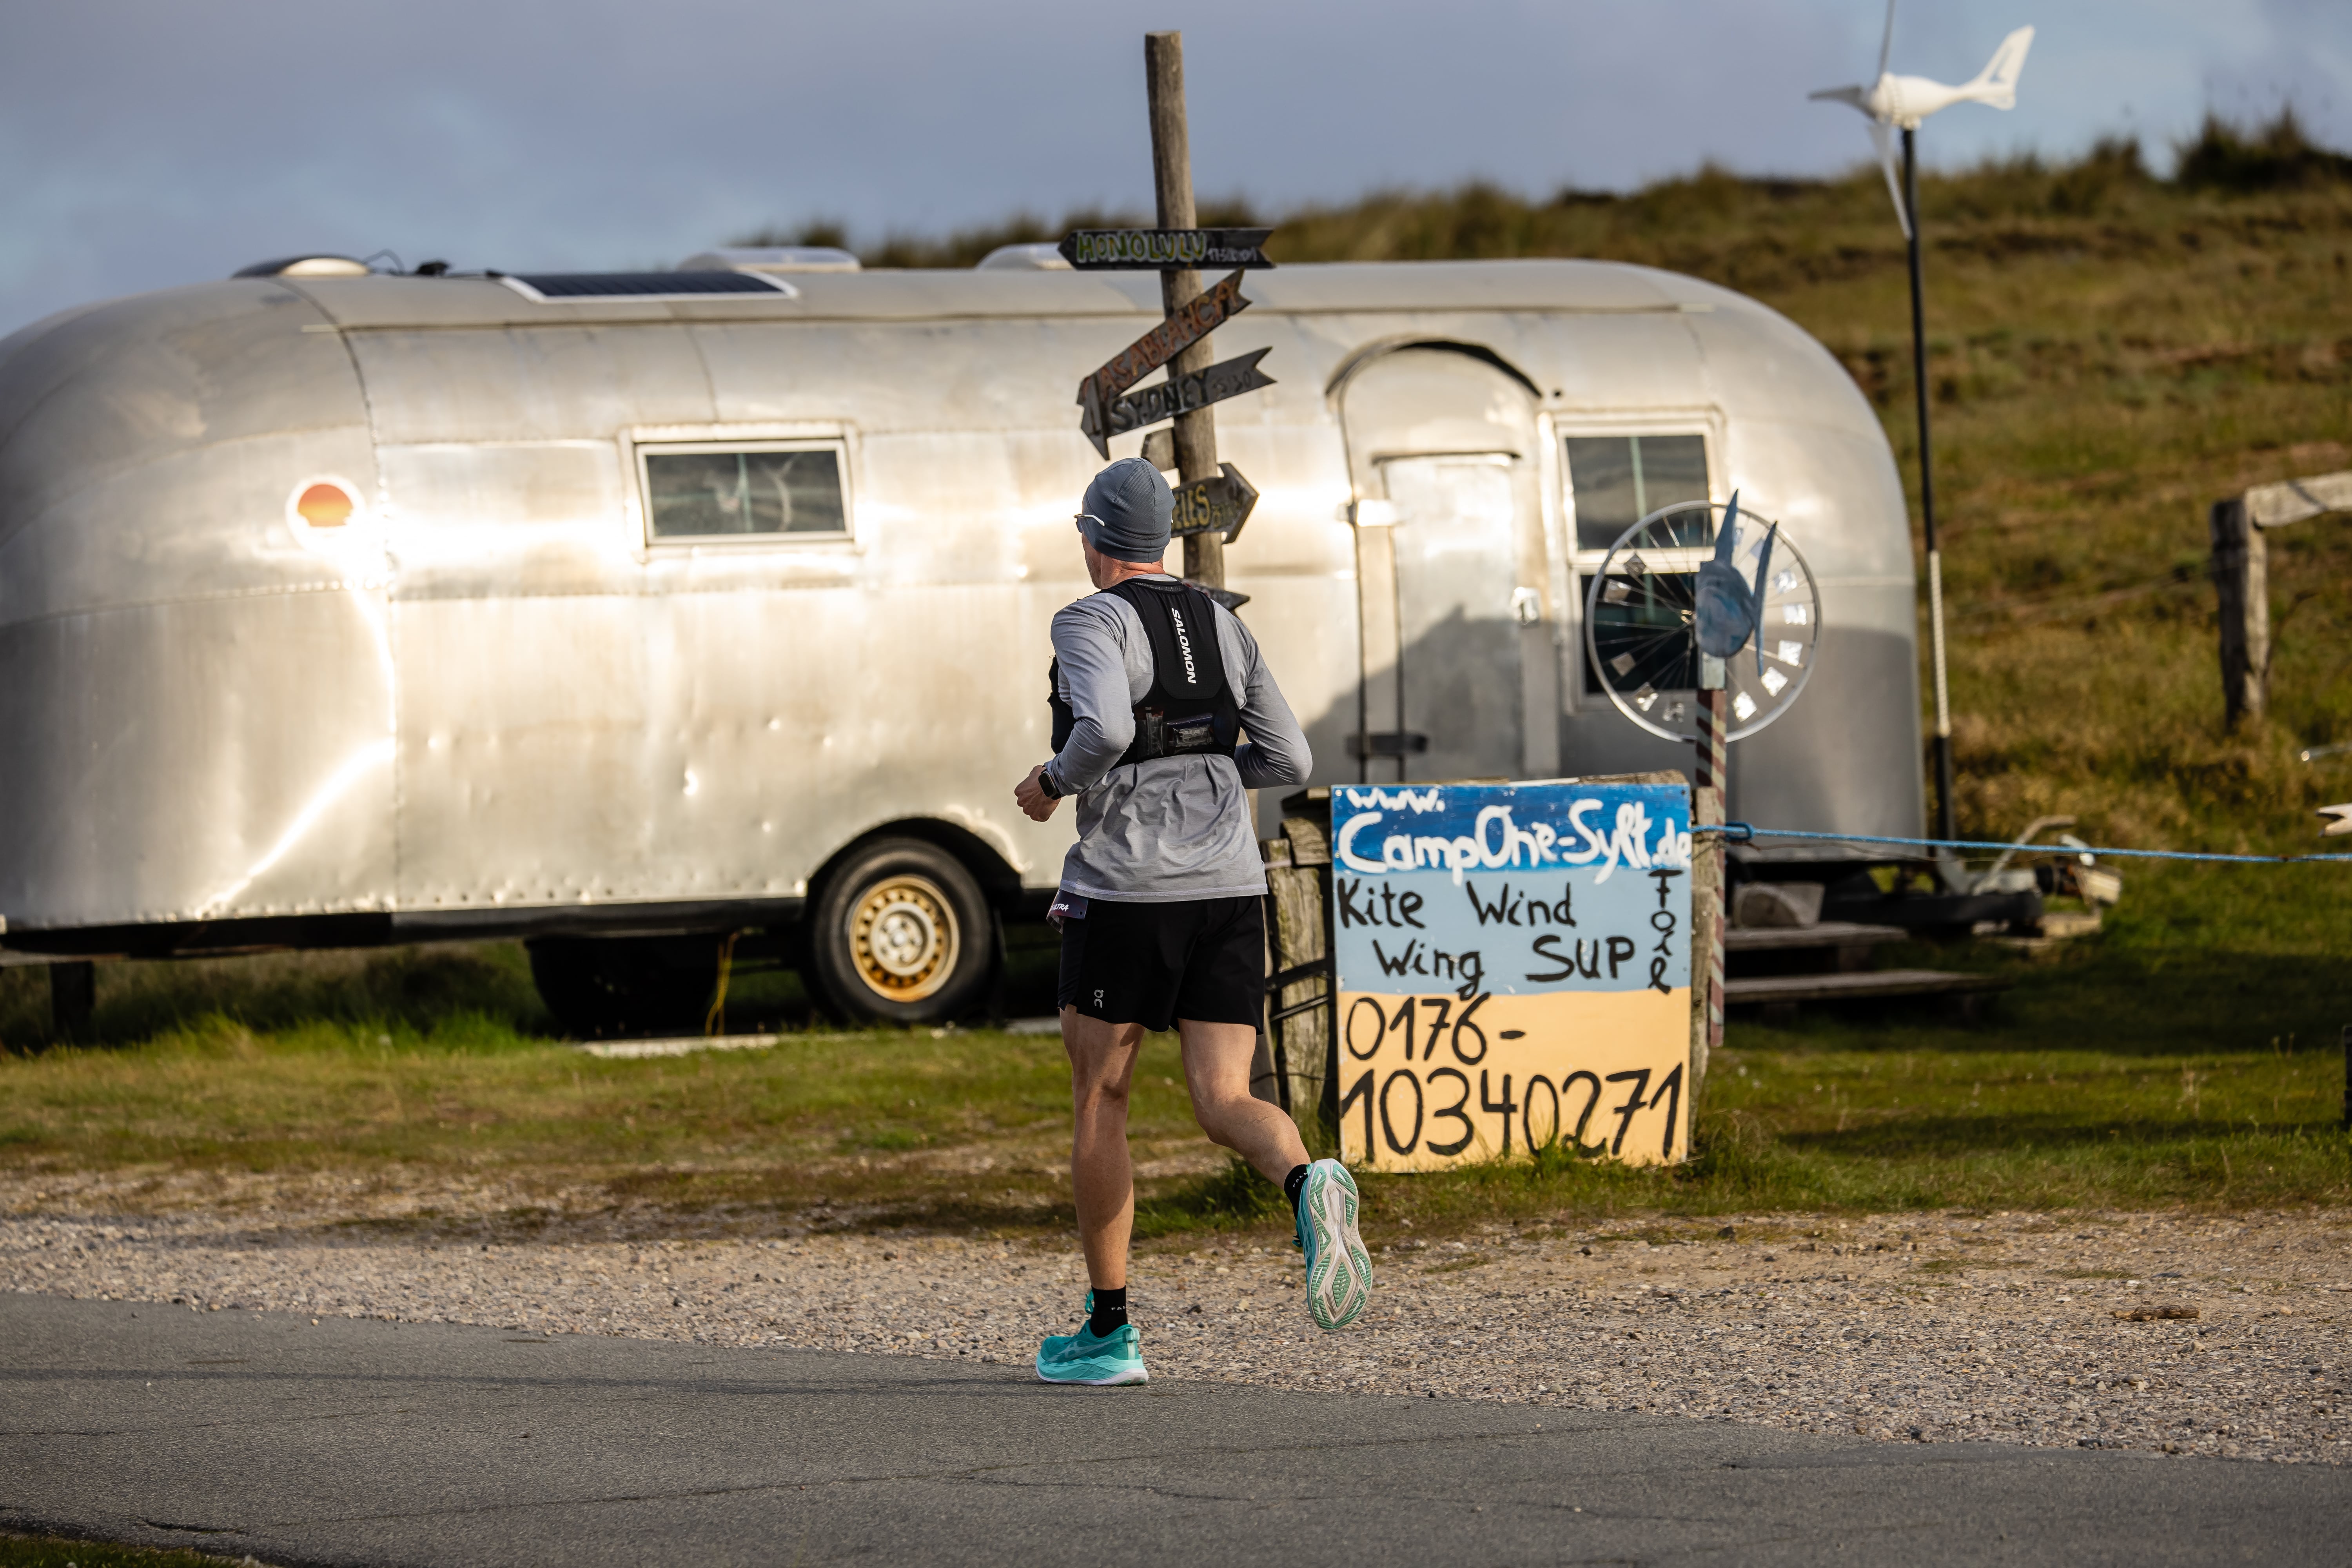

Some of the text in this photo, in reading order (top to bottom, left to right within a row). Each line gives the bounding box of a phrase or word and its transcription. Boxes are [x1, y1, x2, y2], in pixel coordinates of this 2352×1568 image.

[1076, 232, 1207, 262] HONOLULU
[1111, 368, 1210, 431] SYDNEY
[1171, 608, 1197, 684] SALOMON
[1337, 878, 1576, 929] Kite Wind
[1373, 935, 1635, 1000] Wing SUP
[1340, 1062, 1682, 1163] 10340271
